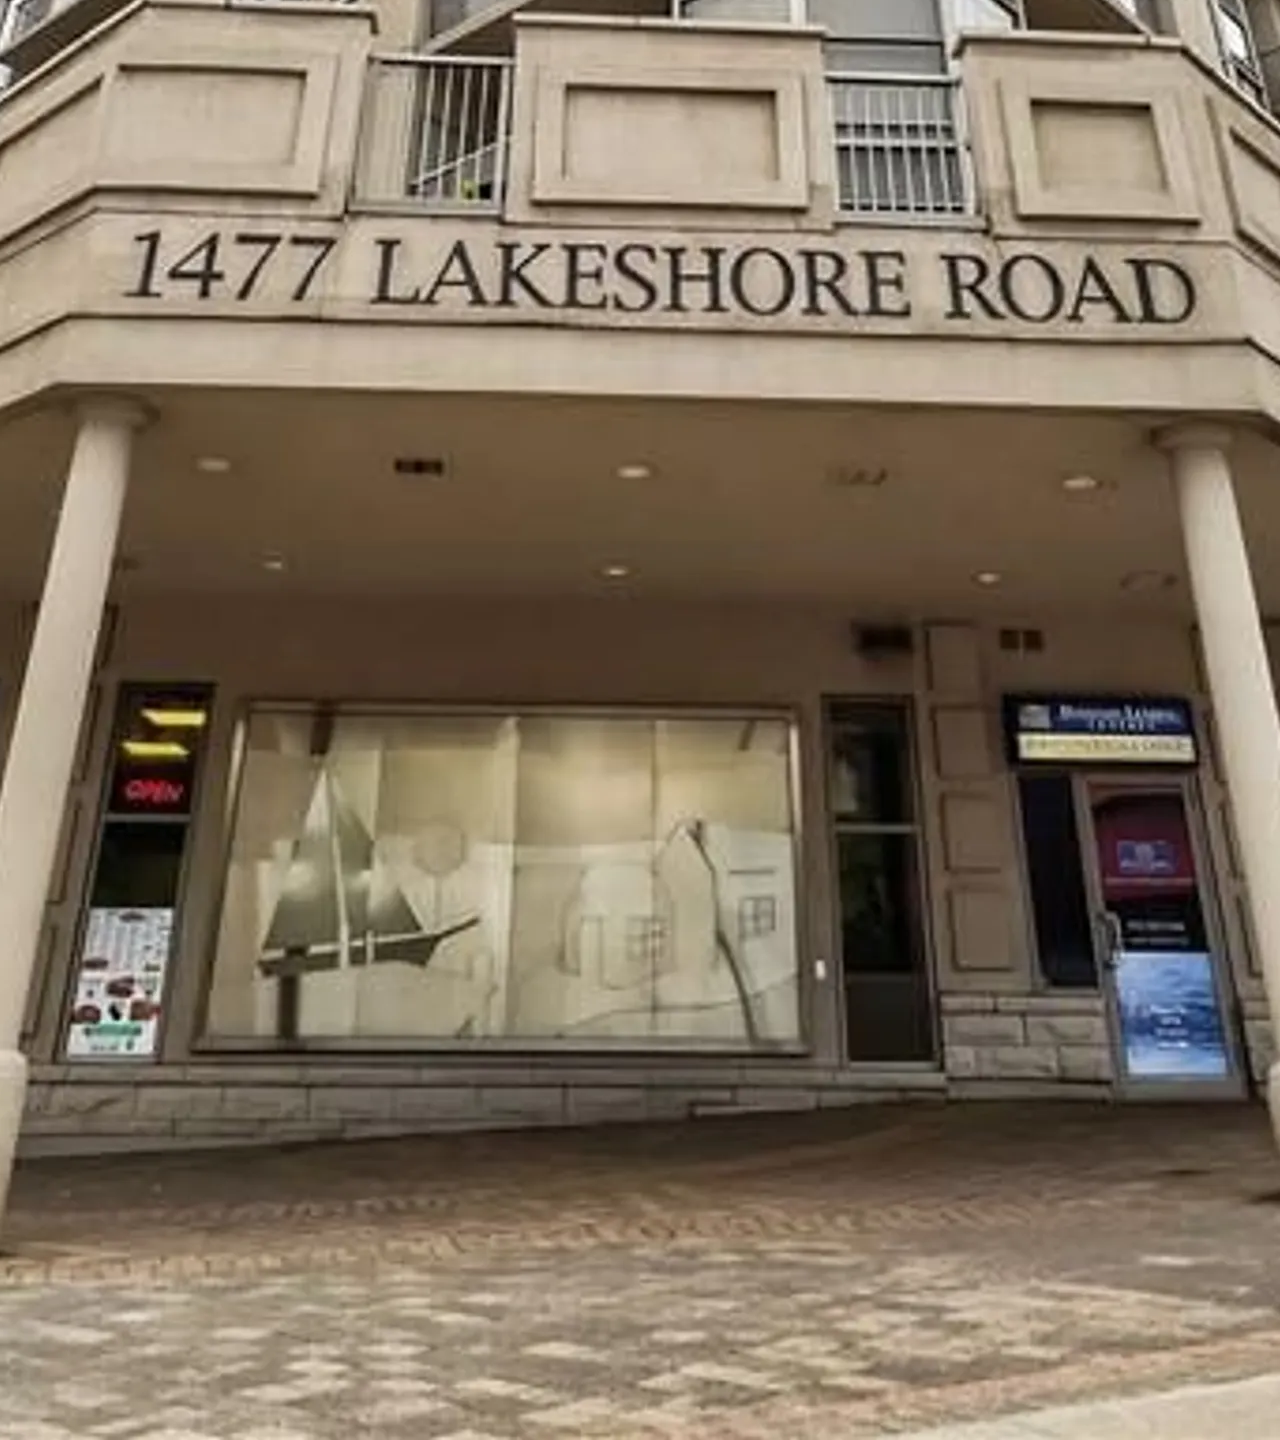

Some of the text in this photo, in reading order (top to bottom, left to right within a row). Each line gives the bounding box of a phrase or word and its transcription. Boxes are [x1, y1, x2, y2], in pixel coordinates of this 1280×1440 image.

[122, 229, 1196, 327] 1477 LAKESHORE ROAD
[124, 776, 183, 800] OPEN
